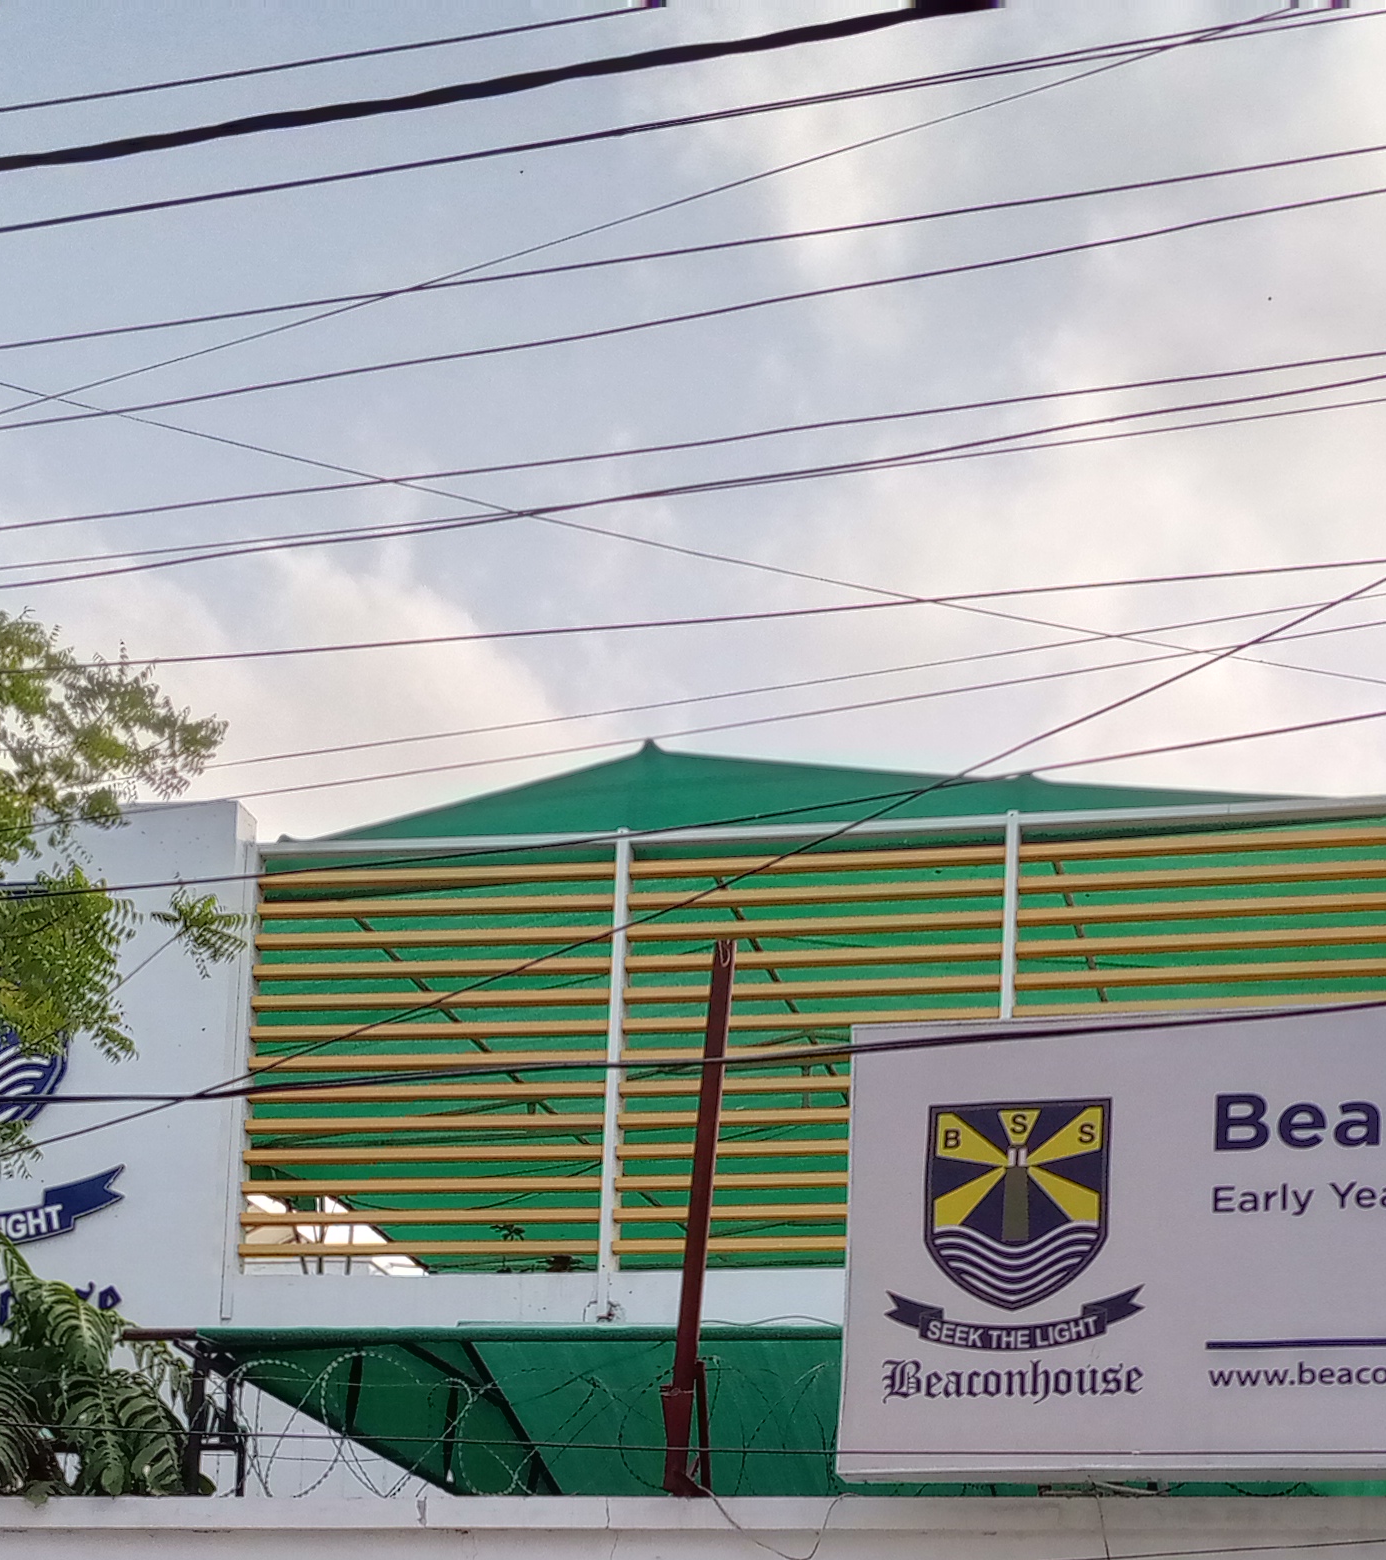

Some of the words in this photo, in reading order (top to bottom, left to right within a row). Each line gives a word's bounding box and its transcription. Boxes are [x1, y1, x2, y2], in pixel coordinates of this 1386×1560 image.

[1212, 1182, 1314, 1216] Early
[927, 1321, 984, 1347] SEEK
[989, 1330, 1031, 1349] THE
[1035, 1316, 1099, 1345] LIGHT
[882, 1360, 1145, 1404] Beaconhouse
